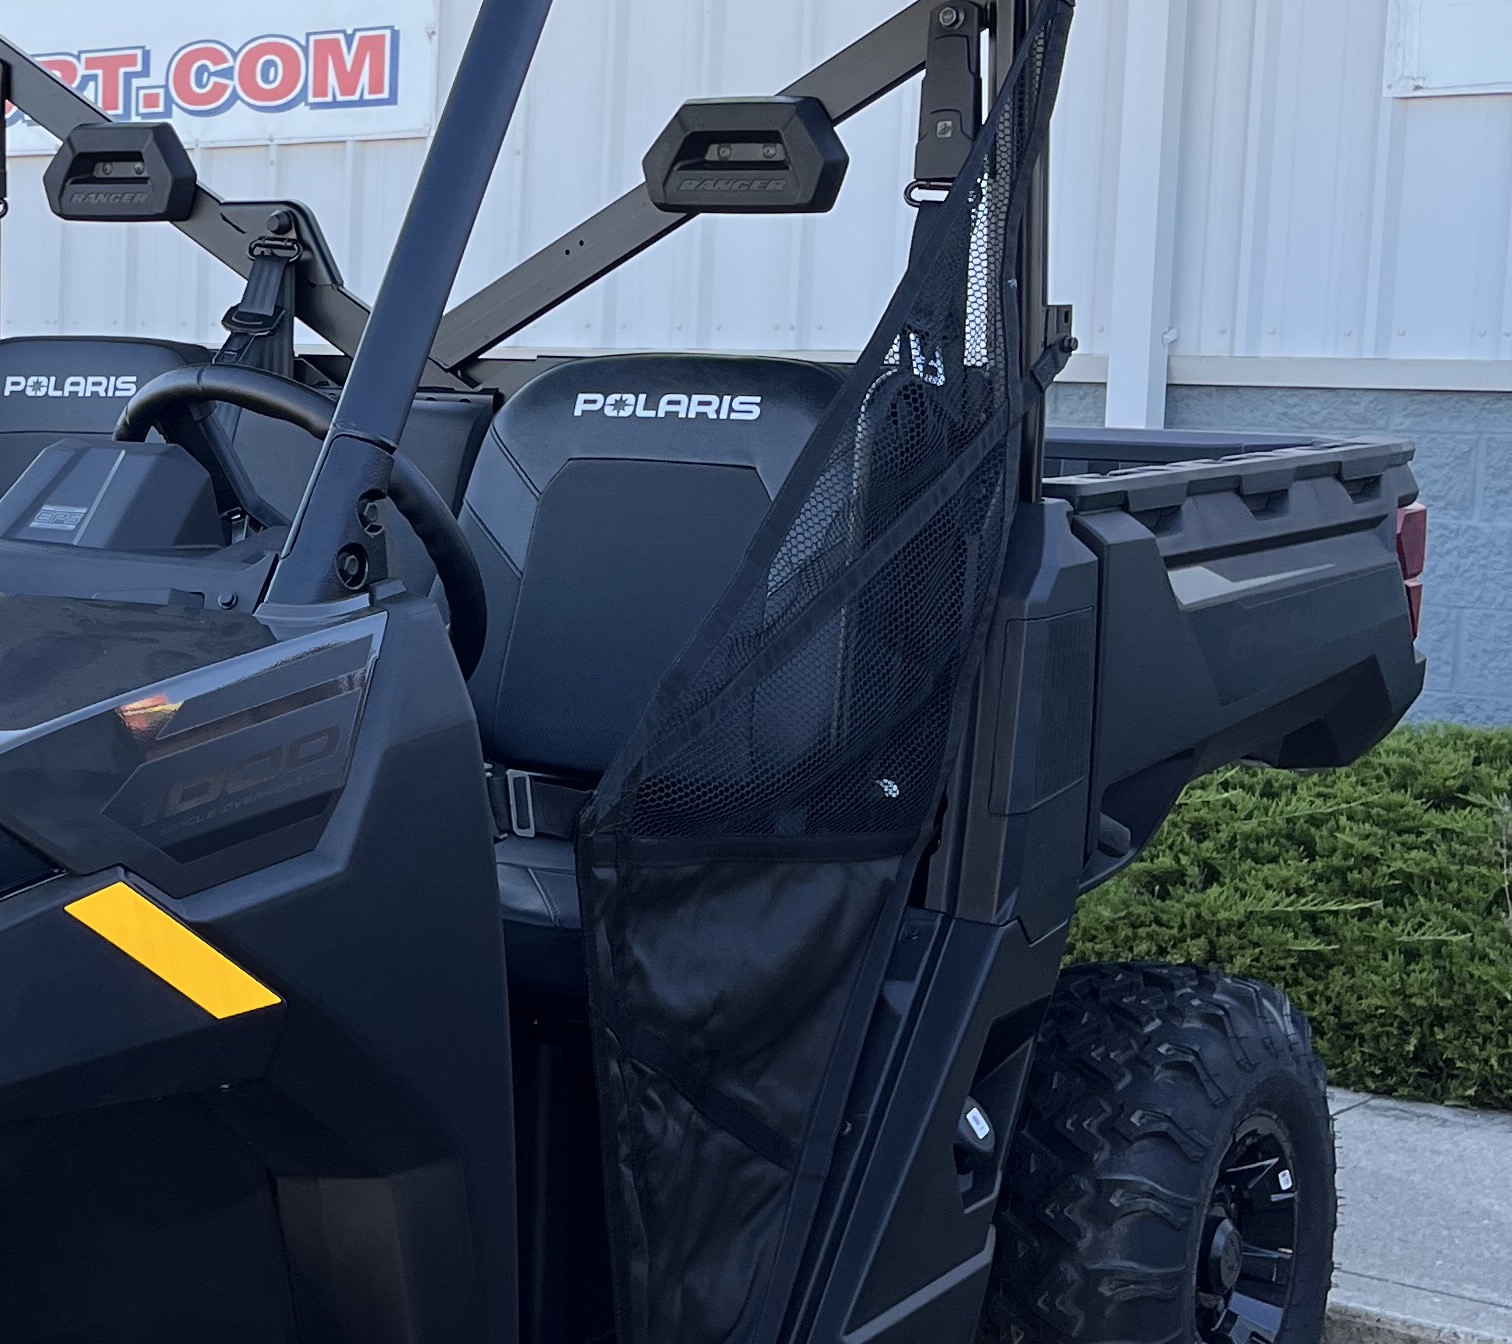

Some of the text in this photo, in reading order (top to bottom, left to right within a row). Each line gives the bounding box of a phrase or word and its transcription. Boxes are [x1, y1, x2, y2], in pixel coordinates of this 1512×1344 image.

[678, 178, 787, 192] RANGER
[69, 192, 149, 204] RANGER
[3, 375, 138, 398] POLARIS
[573, 392, 763, 421] POLARIS
